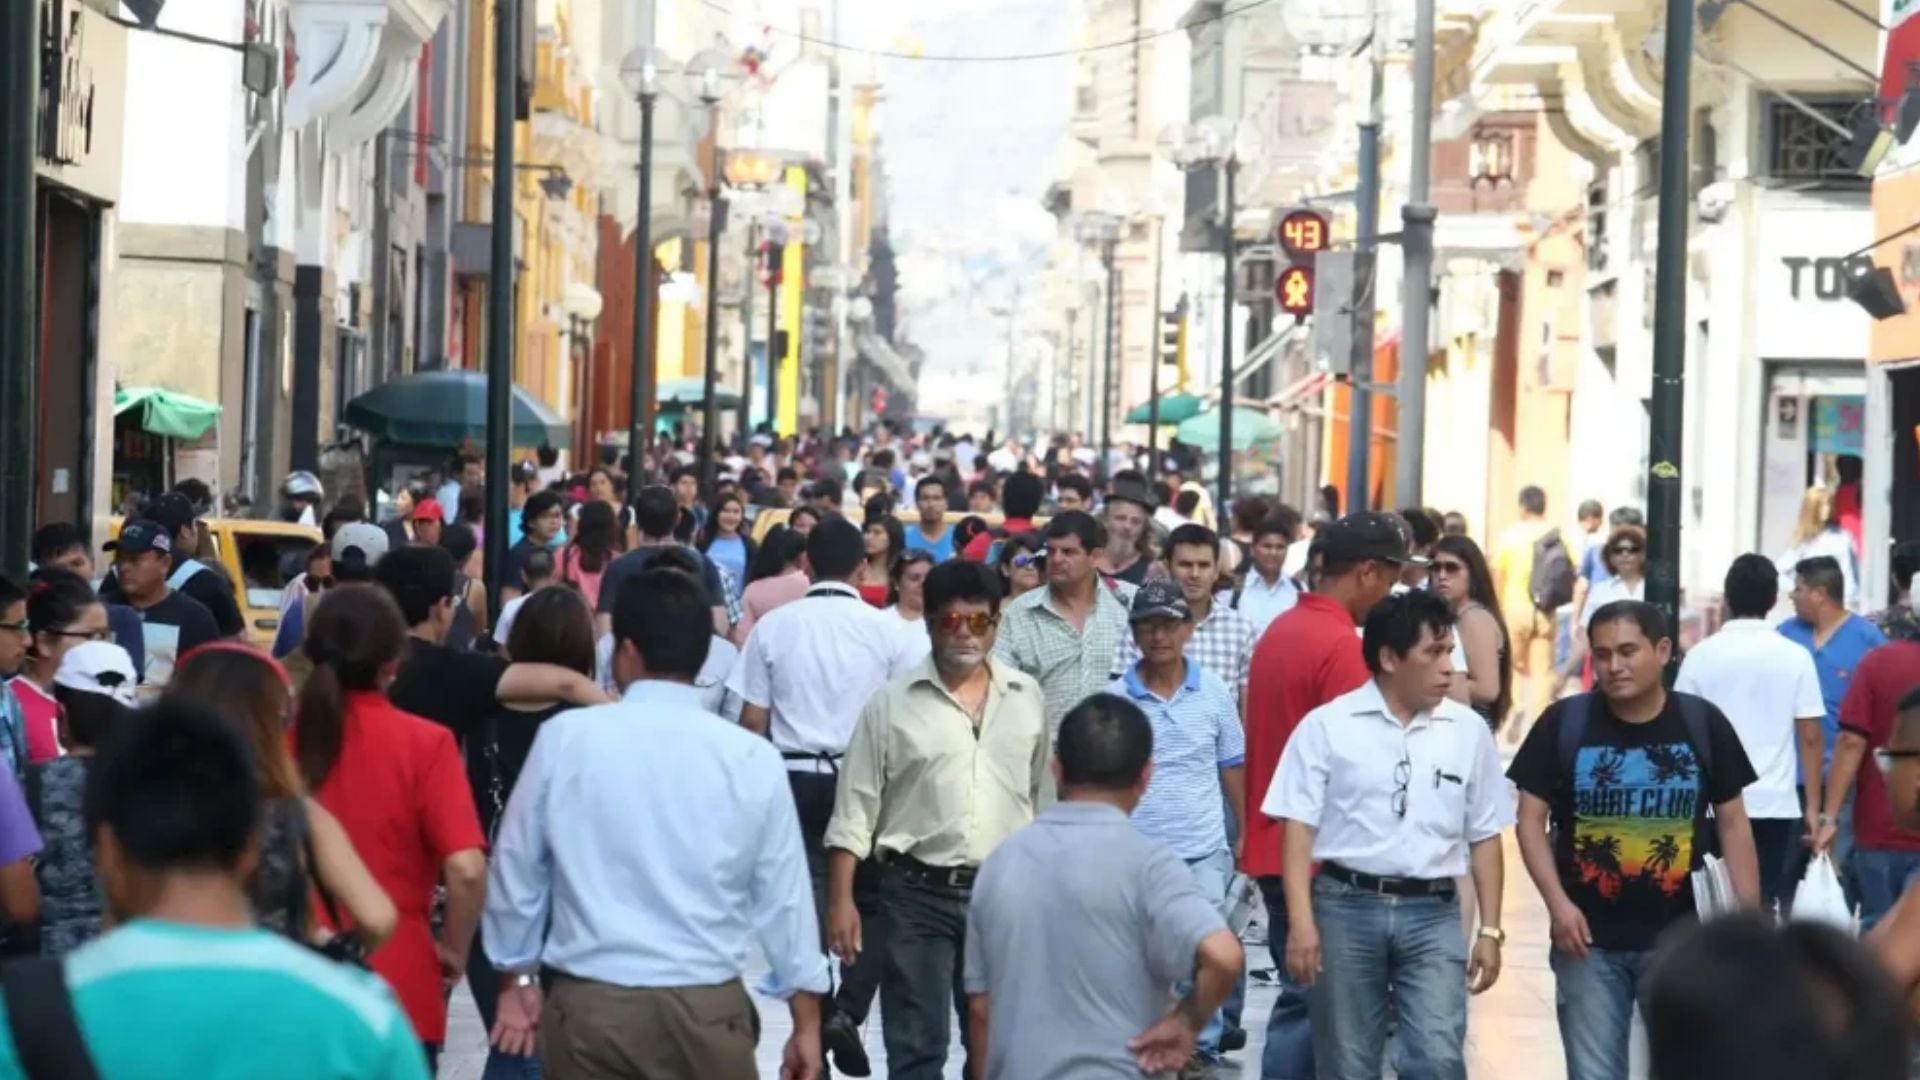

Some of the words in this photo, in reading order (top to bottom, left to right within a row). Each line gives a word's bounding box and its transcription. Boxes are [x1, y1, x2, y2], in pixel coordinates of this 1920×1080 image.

[1285, 220, 1320, 249] 43
[1578, 788, 1638, 817] SURF
[1640, 787, 1696, 819] CLUB
